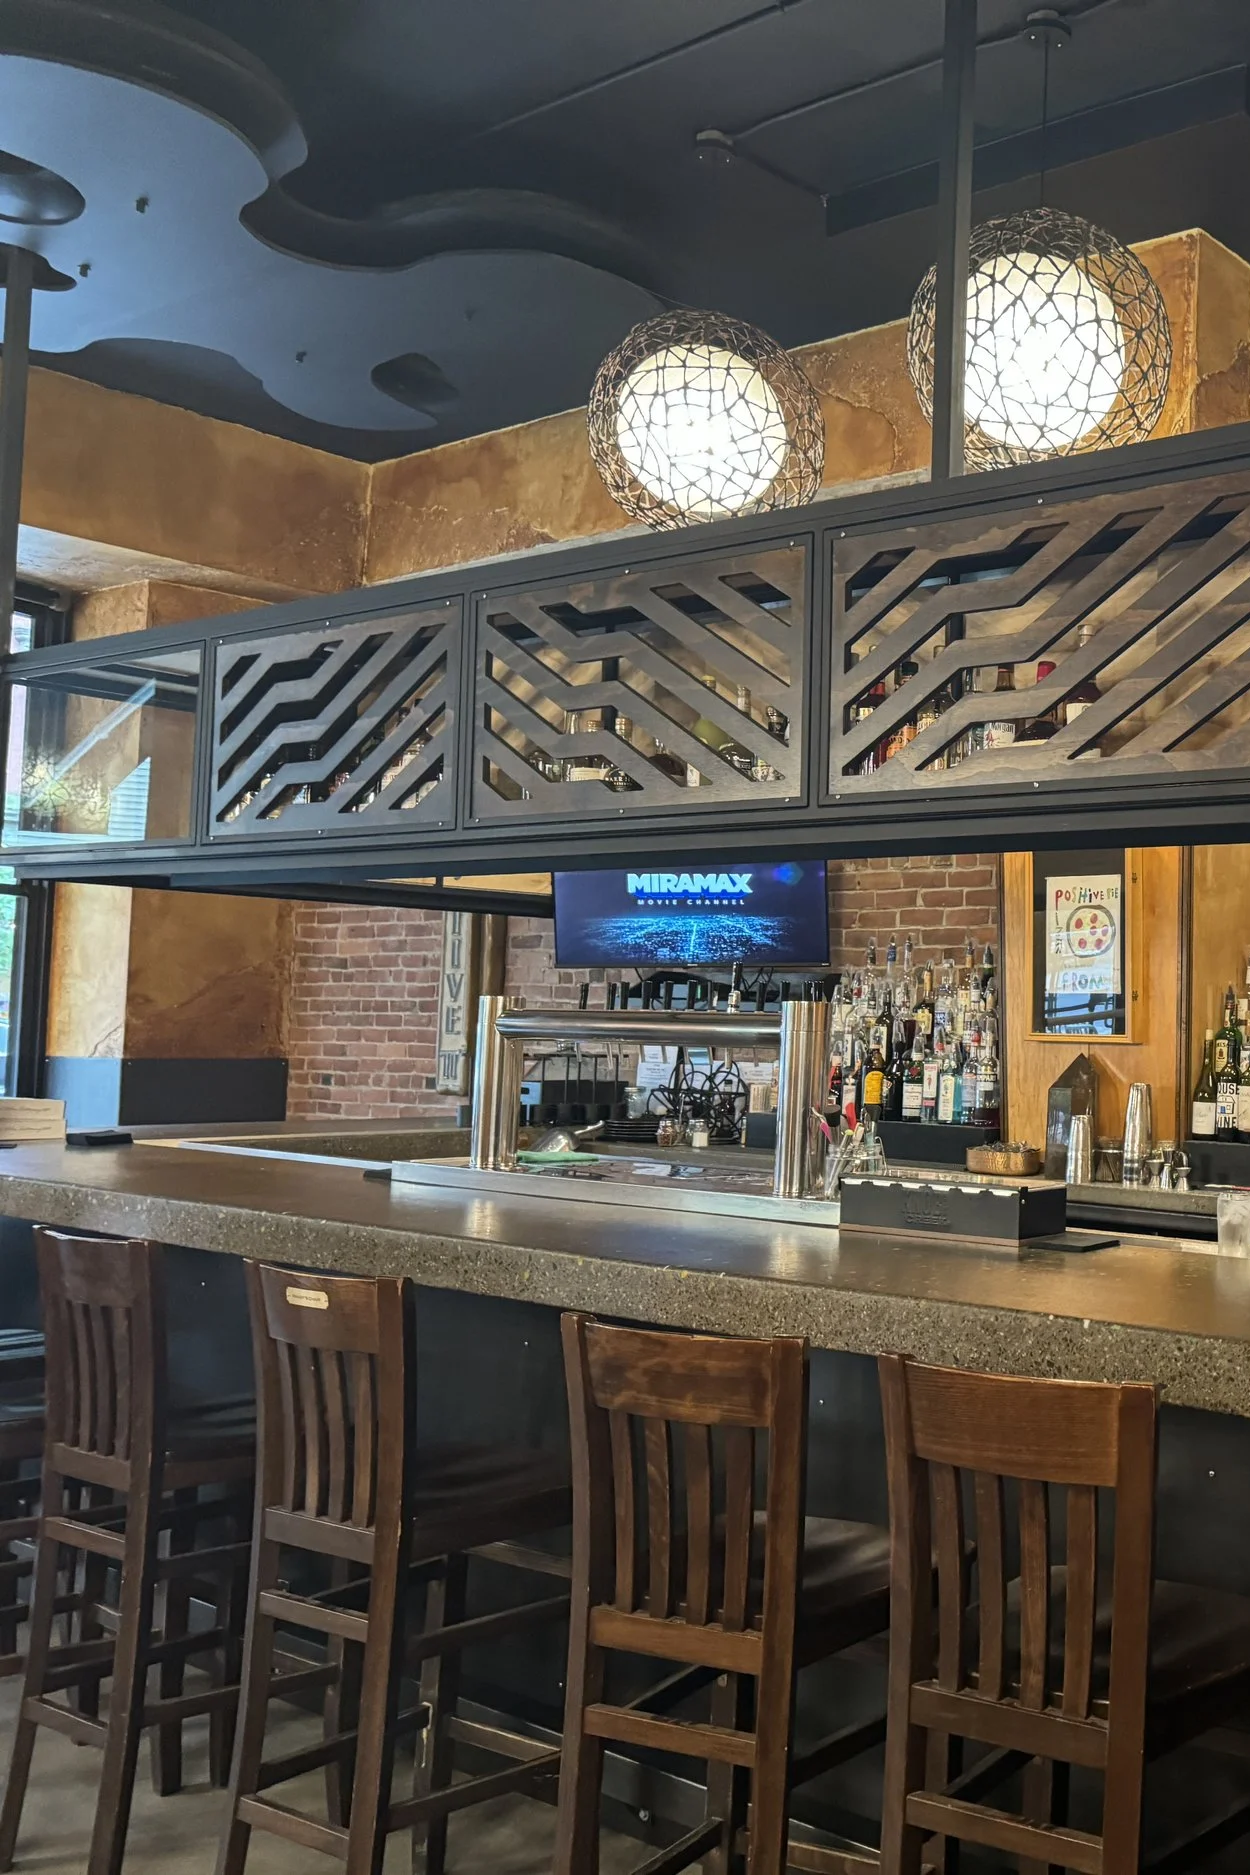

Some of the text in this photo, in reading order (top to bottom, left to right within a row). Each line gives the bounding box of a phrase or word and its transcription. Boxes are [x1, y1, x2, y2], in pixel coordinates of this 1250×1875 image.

[991, 722, 1014, 734] Morgan
[626, 873, 754, 895] MIRAMAX
[637, 898, 746, 906] MOVIE CHANNEL
